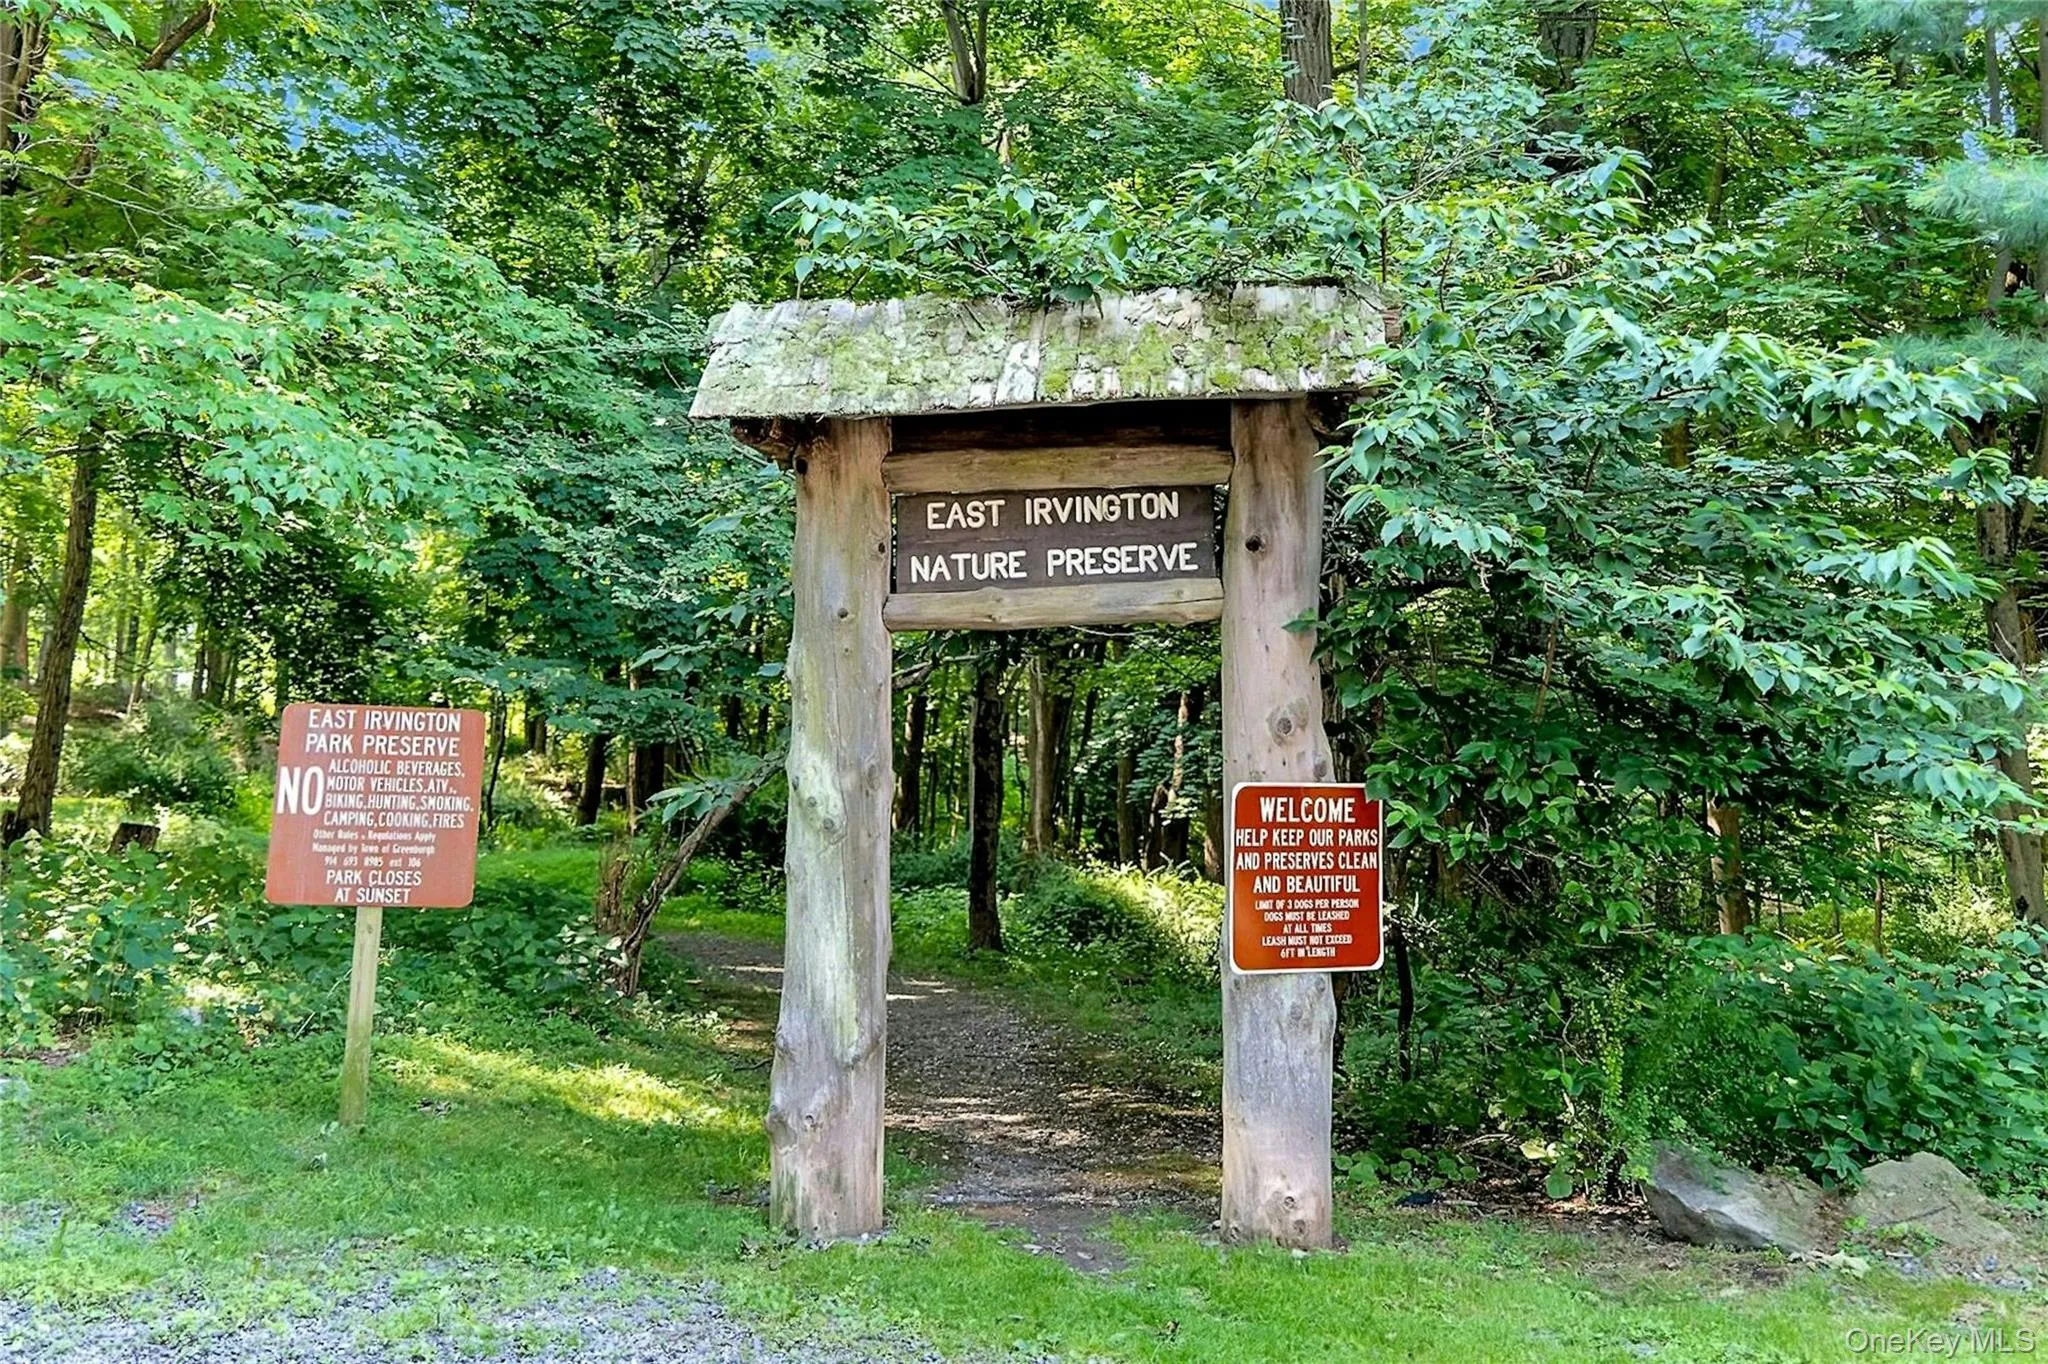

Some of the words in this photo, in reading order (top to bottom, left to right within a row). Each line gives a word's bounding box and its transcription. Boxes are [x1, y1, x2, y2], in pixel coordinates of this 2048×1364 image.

[927, 499, 1006, 530] EAST
[1025, 491, 1179, 526] IRVINGTON
[910, 550, 1028, 583] NATURE
[1046, 542, 1199, 577] PRESERVE
[308, 709, 357, 729] EAST
[364, 710, 461, 732] IRVINGTON
[305, 734, 354, 754] PARK
[362, 735, 460, 757] PRESERVE
[328, 759, 392, 774] ALCOHOLIC
[276, 766, 325, 815] NO
[327, 776, 365, 792] MOTOR
[1259, 797, 1356, 823] WELCOME
[313, 829, 335, 839] Other
[337, 829, 358, 840] Rules
[367, 830, 412, 843] Regulations
[415, 831, 436, 843] Apply
[1236, 828, 1268, 847] HELP
[1272, 828, 1304, 847] KEEP
[1309, 828, 1334, 847] OUR
[1338, 828, 1378, 847] PARKS
[312, 842, 345, 855] Managed
[348, 843, 358, 855] by
[361, 843, 379, 853] Town
[381, 843, 391, 854] of
[324, 855, 337, 866] 914
[343, 856, 359, 867] 693
[1236, 852, 1260, 871] AND
[1264, 852, 1334, 871] PRESERVES
[1338, 851, 1377, 870] CLEAN
[326, 870, 362, 885] PARK
[369, 870, 422, 886] CLOSES
[1253, 875, 1281, 894] AND
[1286, 875, 1361, 893] BEAUTIFUL
[334, 888, 350, 904] AT
[356, 888, 411, 904] SUNSET
[1255, 900, 1273, 910] LIMIT
[1276, 900, 1285, 910] OF
[1287, 900, 1292, 910] 3
[1294, 899, 1314, 910] DOGS
[1315, 899, 1330, 909] PER
[1331, 898, 1360, 909] PERSON
[1264, 911, 1283, 922] DOGS
[1285, 911, 1304, 922] MUST
[1306, 911, 1316, 922] BE
[1318, 910, 1350, 921] LEASHED
[1283, 924, 1292, 934] AT
[1295, 924, 1308, 934] ALL
[1311, 923, 1333, 933] TIMES
[1262, 936, 1287, 947] LEASH
[1288, 935, 1307, 946] MUST
[1309, 935, 1324, 945] NOT
[1325, 934, 1353, 945] EXCEED
[1280, 948, 1296, 959] 6FT
[1297, 948, 1306, 958] IN
[1307, 947, 1336, 957] LENGTH
